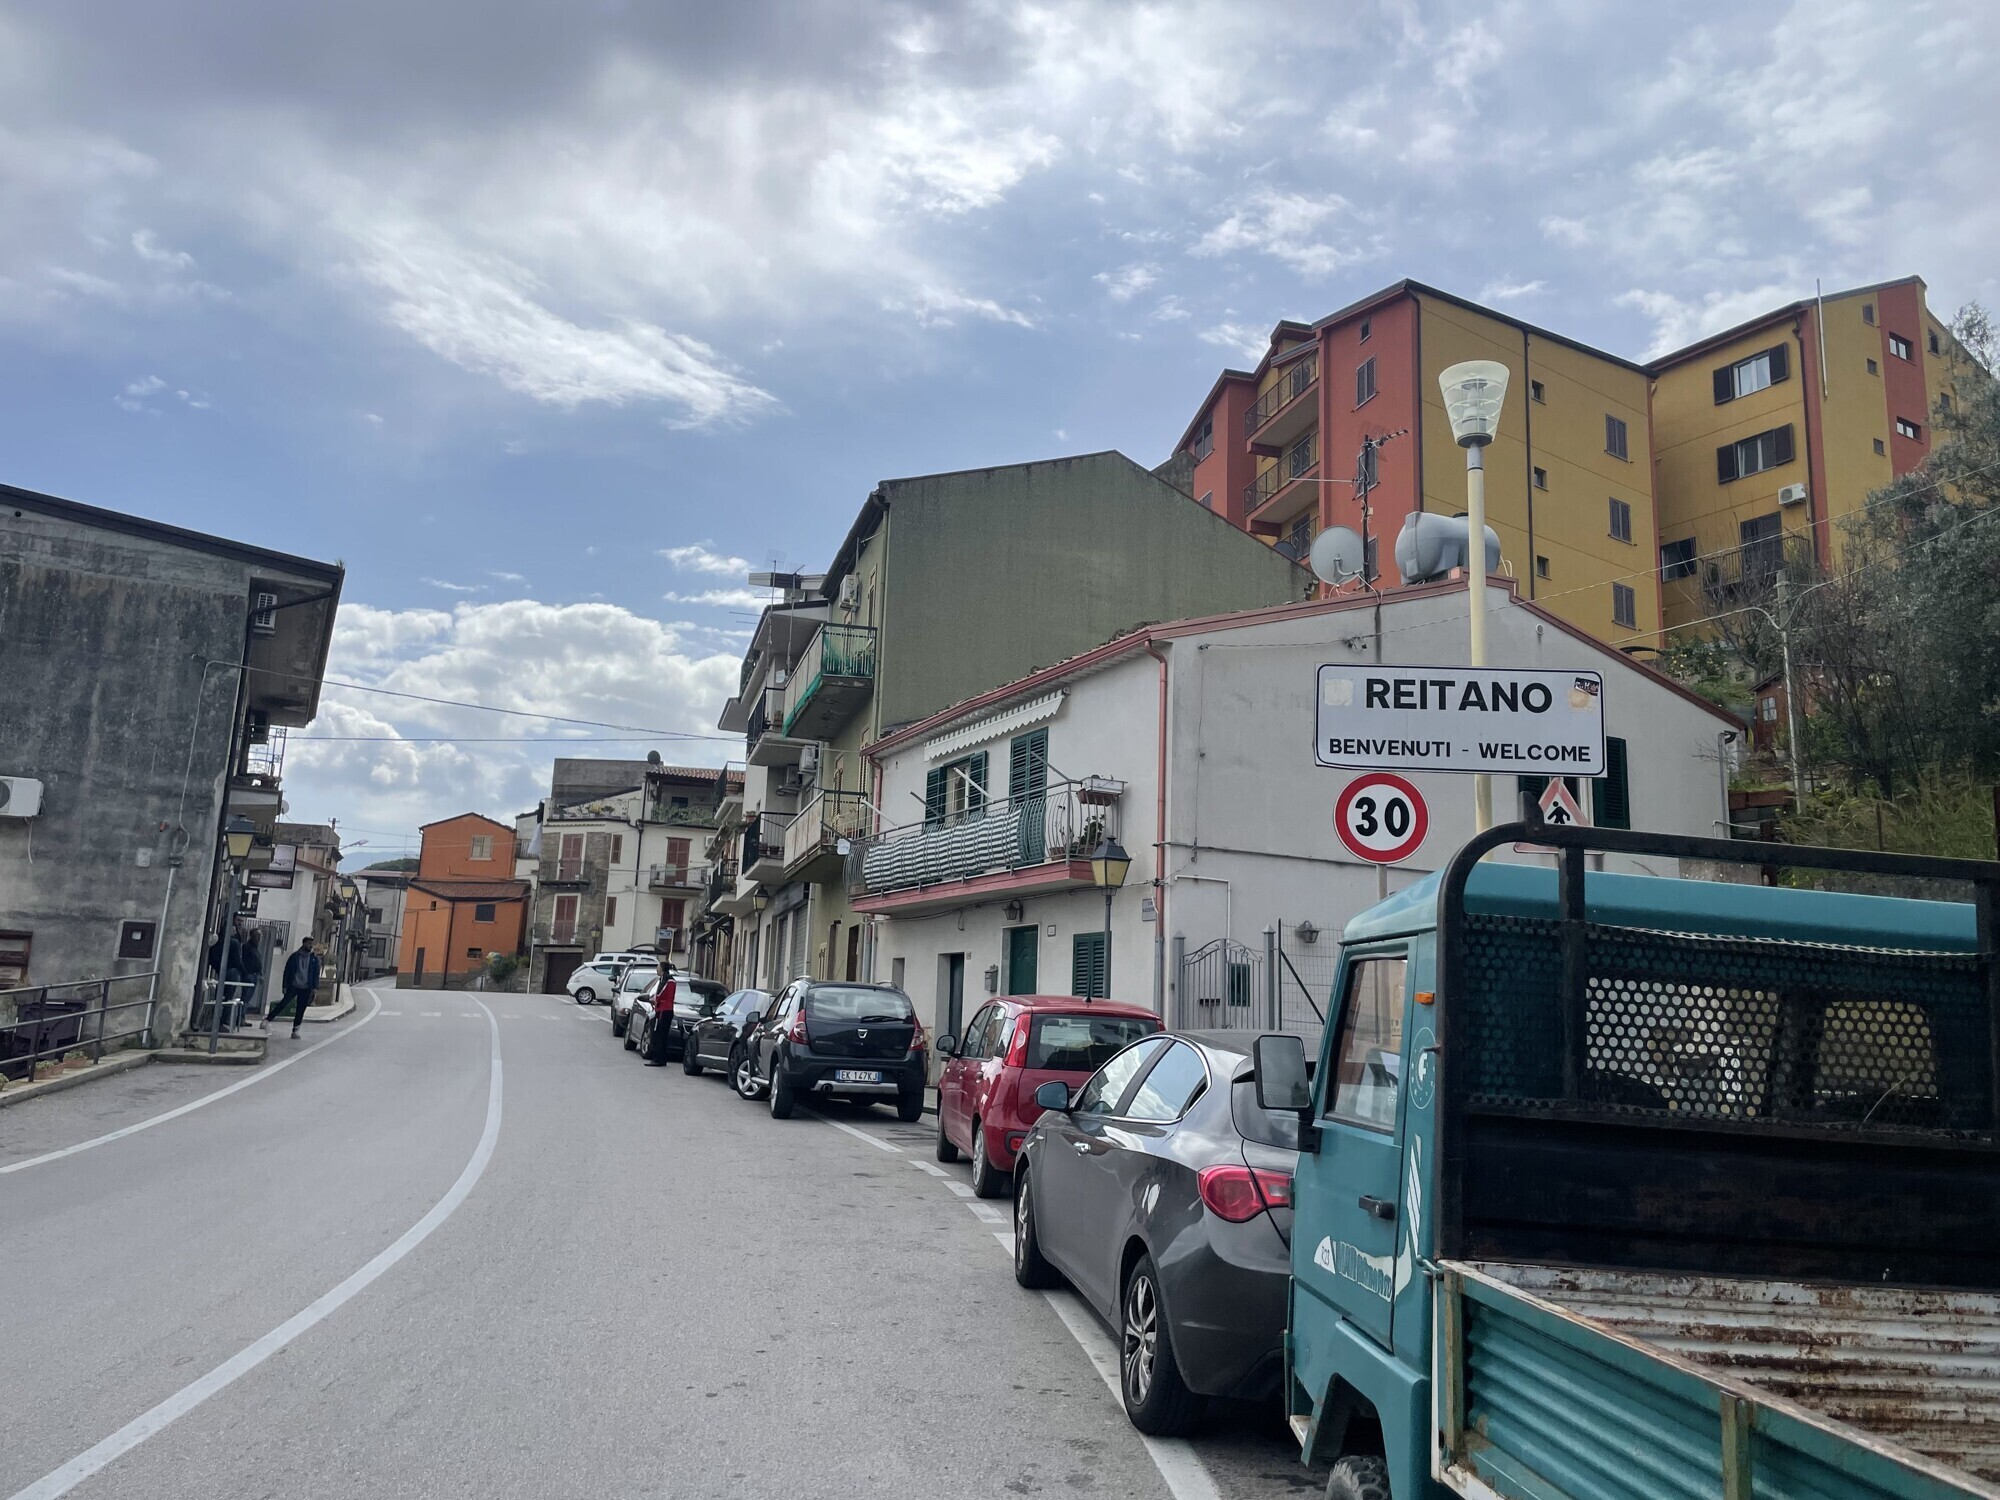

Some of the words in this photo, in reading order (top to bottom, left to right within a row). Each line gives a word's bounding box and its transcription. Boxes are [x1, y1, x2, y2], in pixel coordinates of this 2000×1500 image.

[1366, 678, 1552, 713] REITANO
[1329, 738, 1451, 758] BENVENUTI
[1479, 742, 1591, 762] WELCOME
[1354, 796, 1410, 838] 30
[841, 1070, 851, 1080] EK
[854, 1071, 878, 1081] 147KJ
